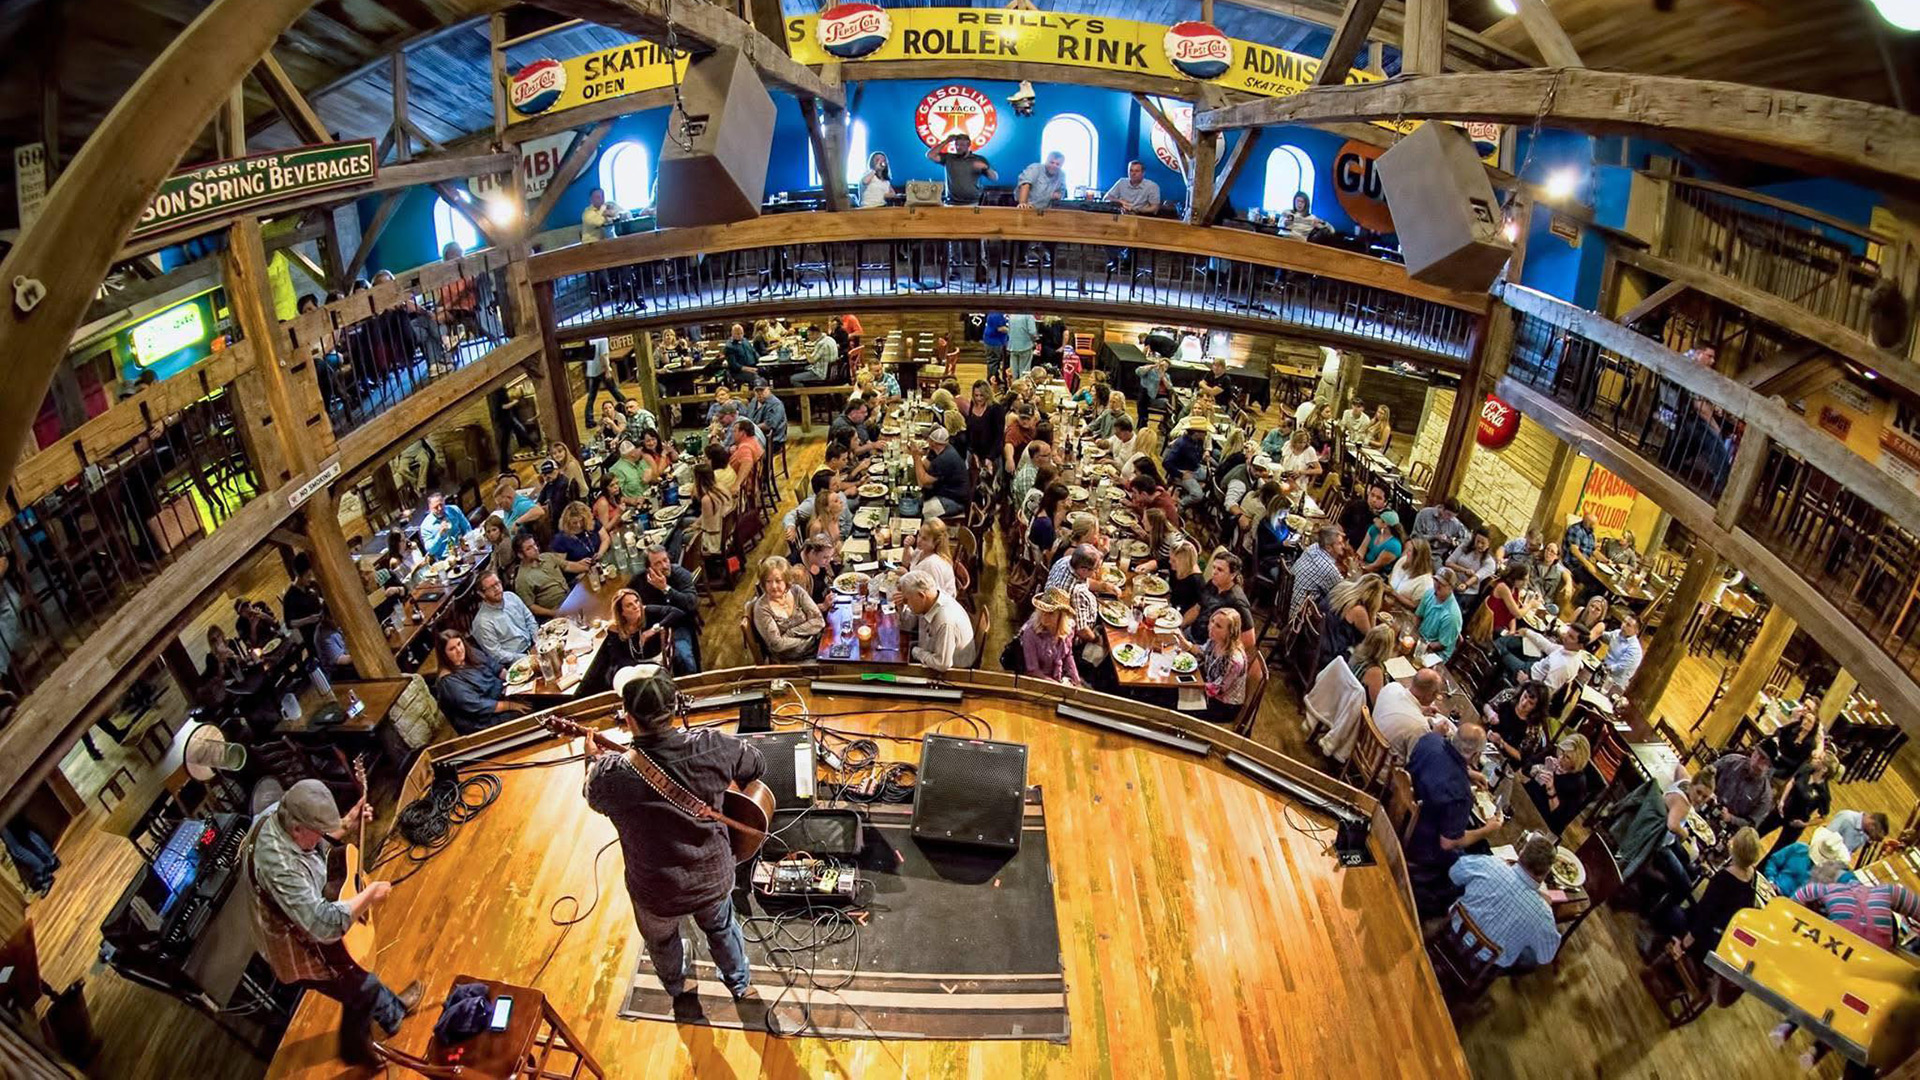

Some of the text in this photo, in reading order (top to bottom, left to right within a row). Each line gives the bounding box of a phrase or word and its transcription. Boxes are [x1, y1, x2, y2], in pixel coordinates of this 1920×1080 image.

[958, 12, 1105, 34] REILLYS
[903, 29, 1150, 69] ROLLER RINK
[582, 78, 625, 99] OPEN
[919, 86, 995, 114] GASOLINE
[975, 124, 996, 146] OIL
[188, 172, 266, 209] SPRING
[269, 154, 370, 191] BEVERAGES
[204, 157, 279, 181] ASK FOR
[299, 471, 332, 498] NO SMOKING
[1791, 917, 1855, 962] TAXI
